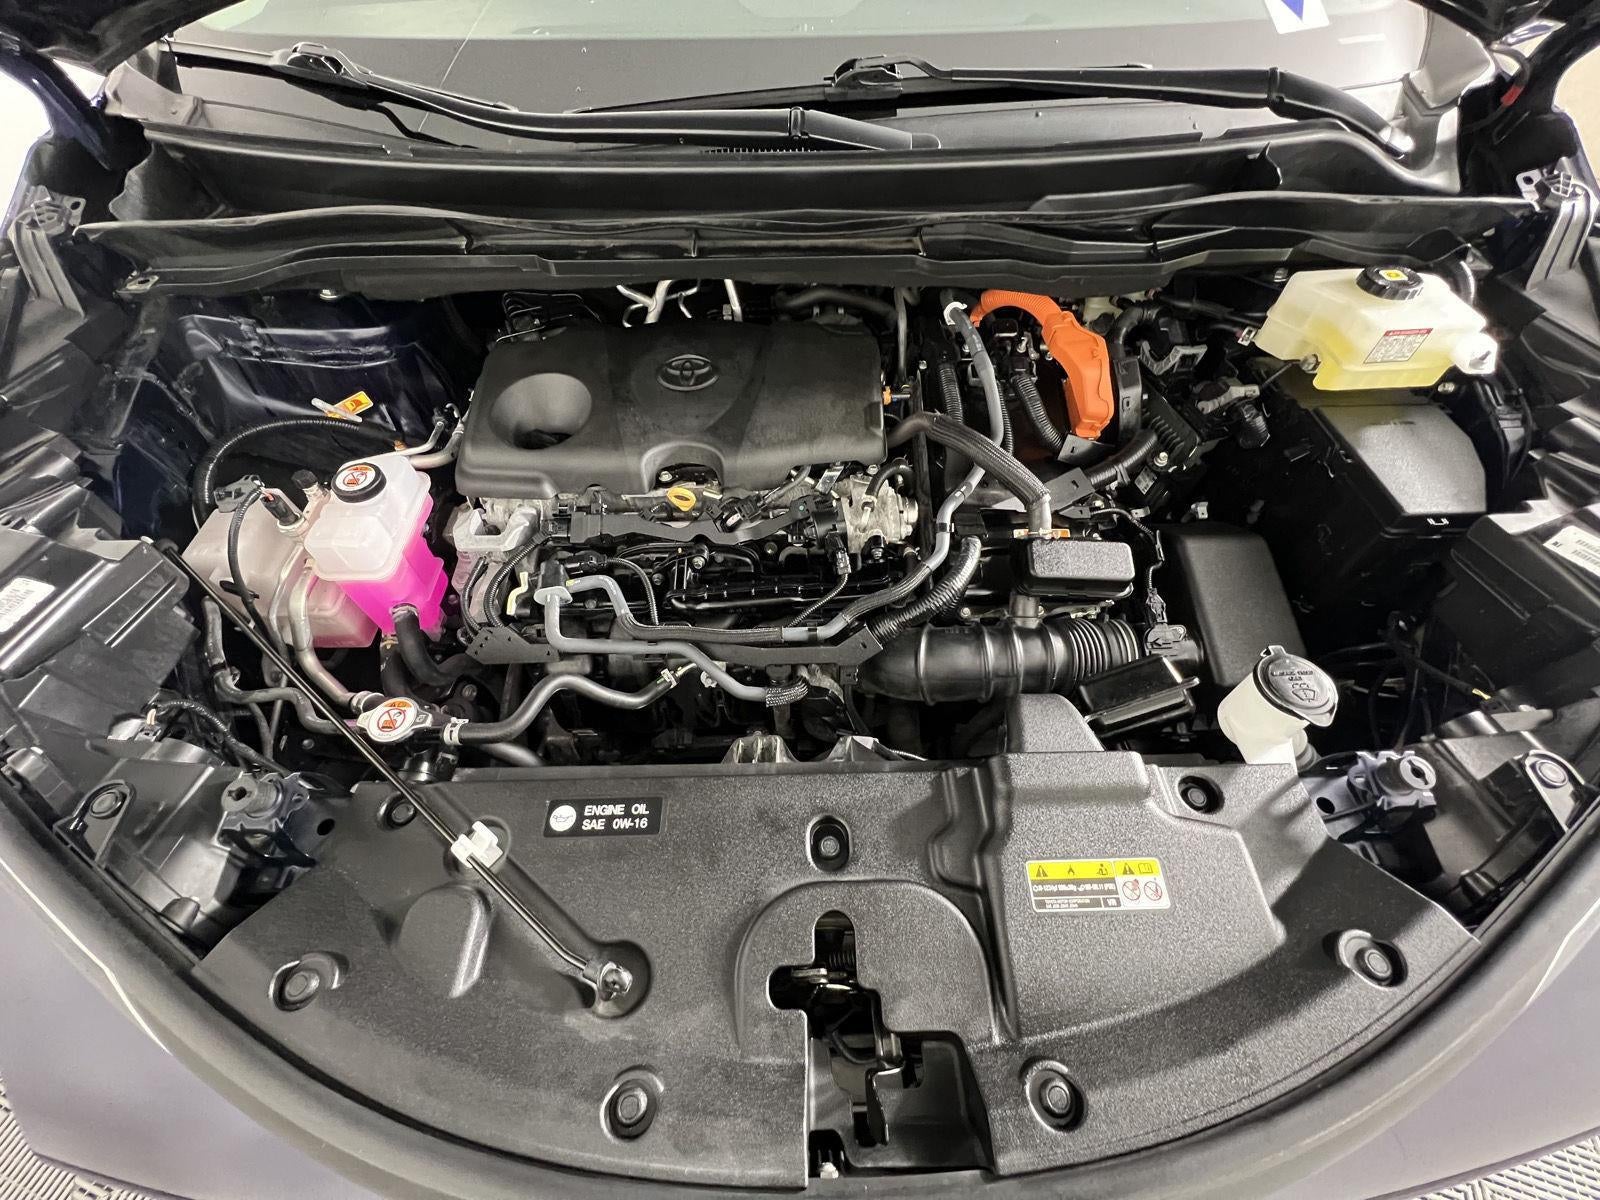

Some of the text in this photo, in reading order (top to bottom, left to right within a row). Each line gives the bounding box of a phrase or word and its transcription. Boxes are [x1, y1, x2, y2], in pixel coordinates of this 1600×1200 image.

[583, 803, 650, 816] ENGINE OIL
[581, 818, 648, 831] SAE 0W-16
